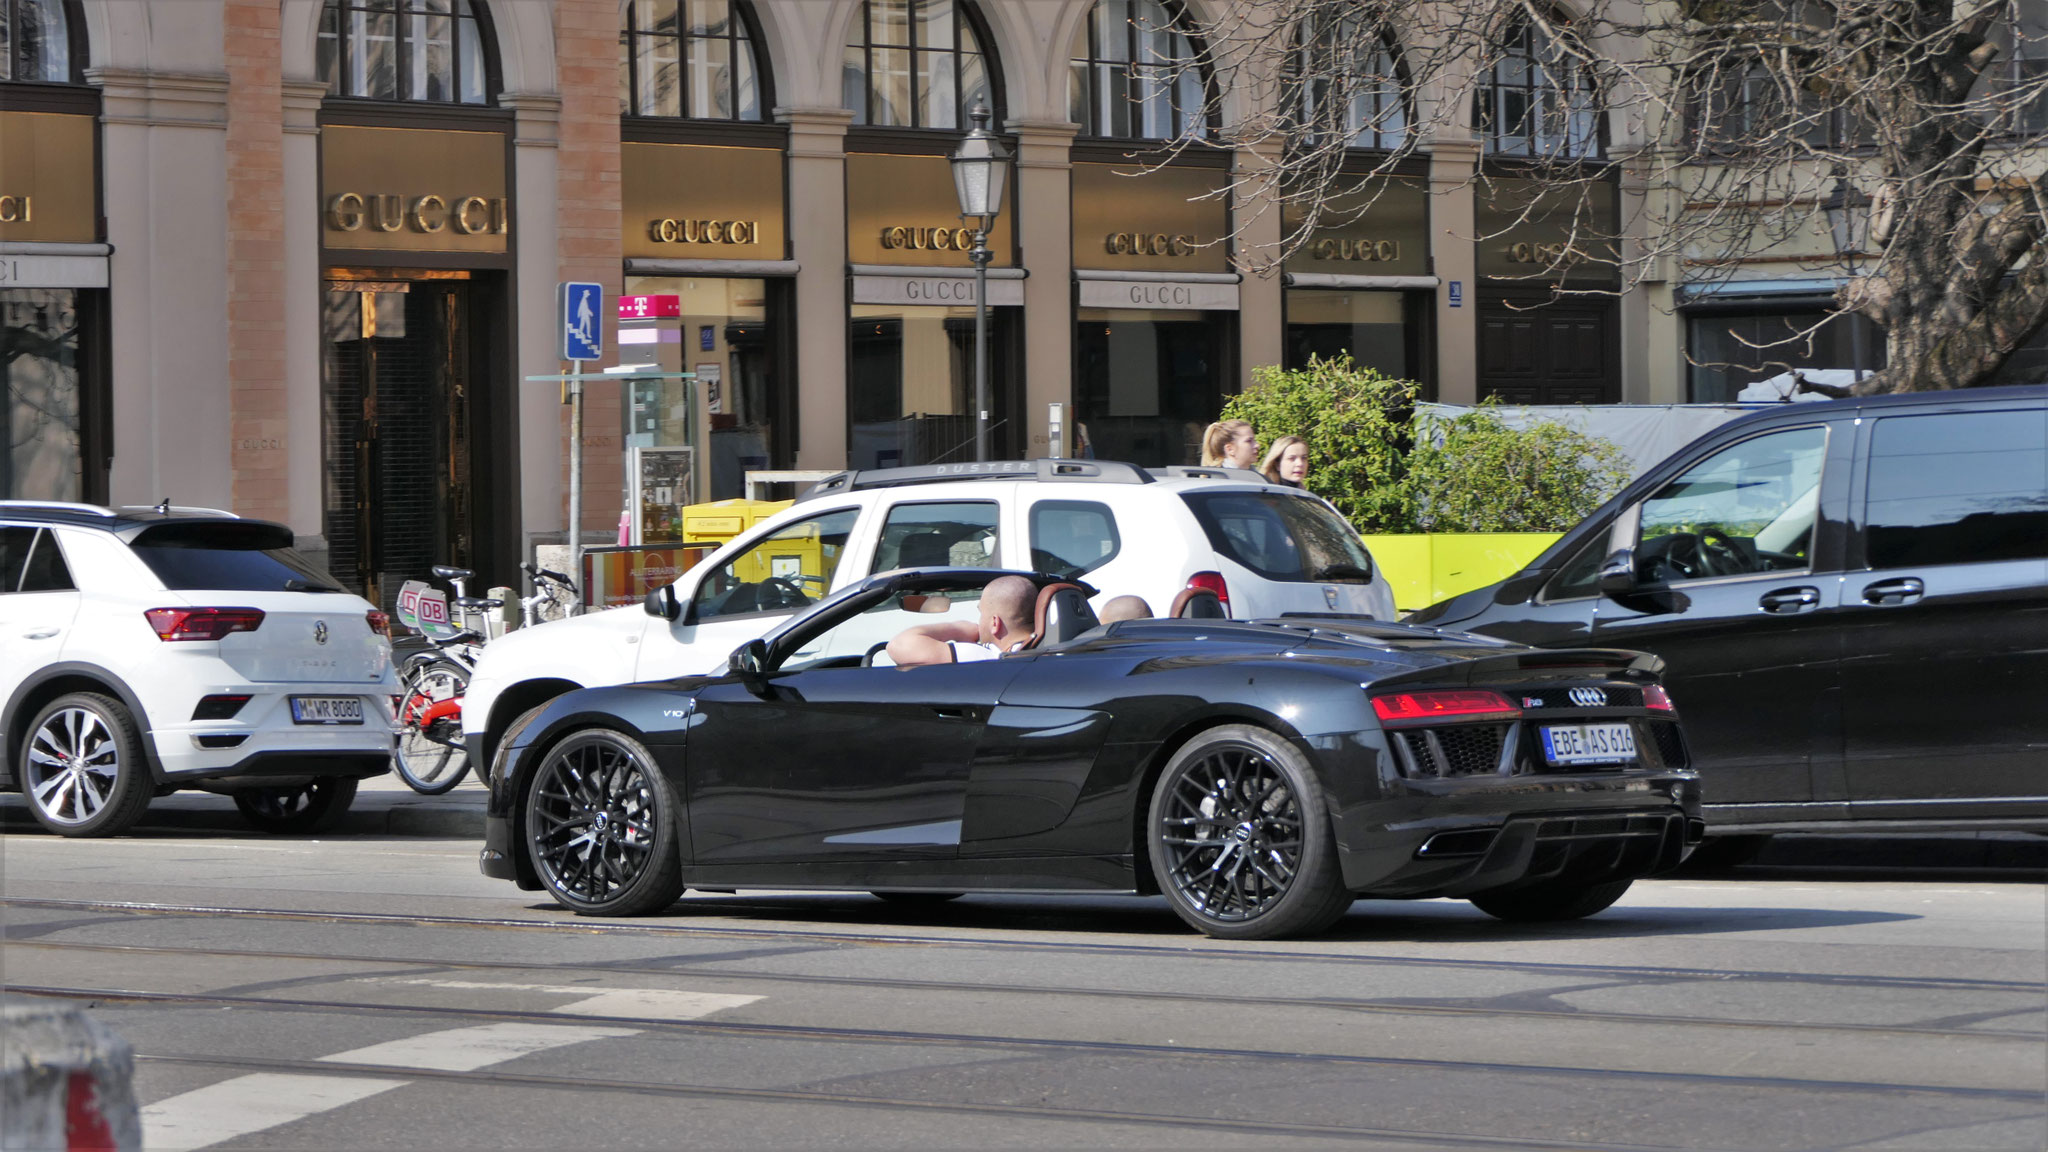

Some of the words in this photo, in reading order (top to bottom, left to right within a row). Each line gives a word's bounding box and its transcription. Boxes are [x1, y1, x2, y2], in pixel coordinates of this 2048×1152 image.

[334, 192, 507, 235] GUCCI
[658, 218, 758, 245] GUCCI
[888, 226, 977, 251] GUCC
[1112, 232, 1198, 256] GUCCI
[1321, 238, 1401, 262] GUCCI
[906, 280, 974, 300] GUCCI
[1130, 285, 1191, 305] GUCCI
[936, 462, 1030, 474] DUSTER
[422, 602, 442, 619] DB
[299, 700, 309, 717] M
[314, 700, 331, 718] WR
[332, 701, 360, 717] 8080
[1551, 730, 1582, 755] EBE
[1590, 729, 1609, 753] AS
[1610, 727, 1634, 752] 616
